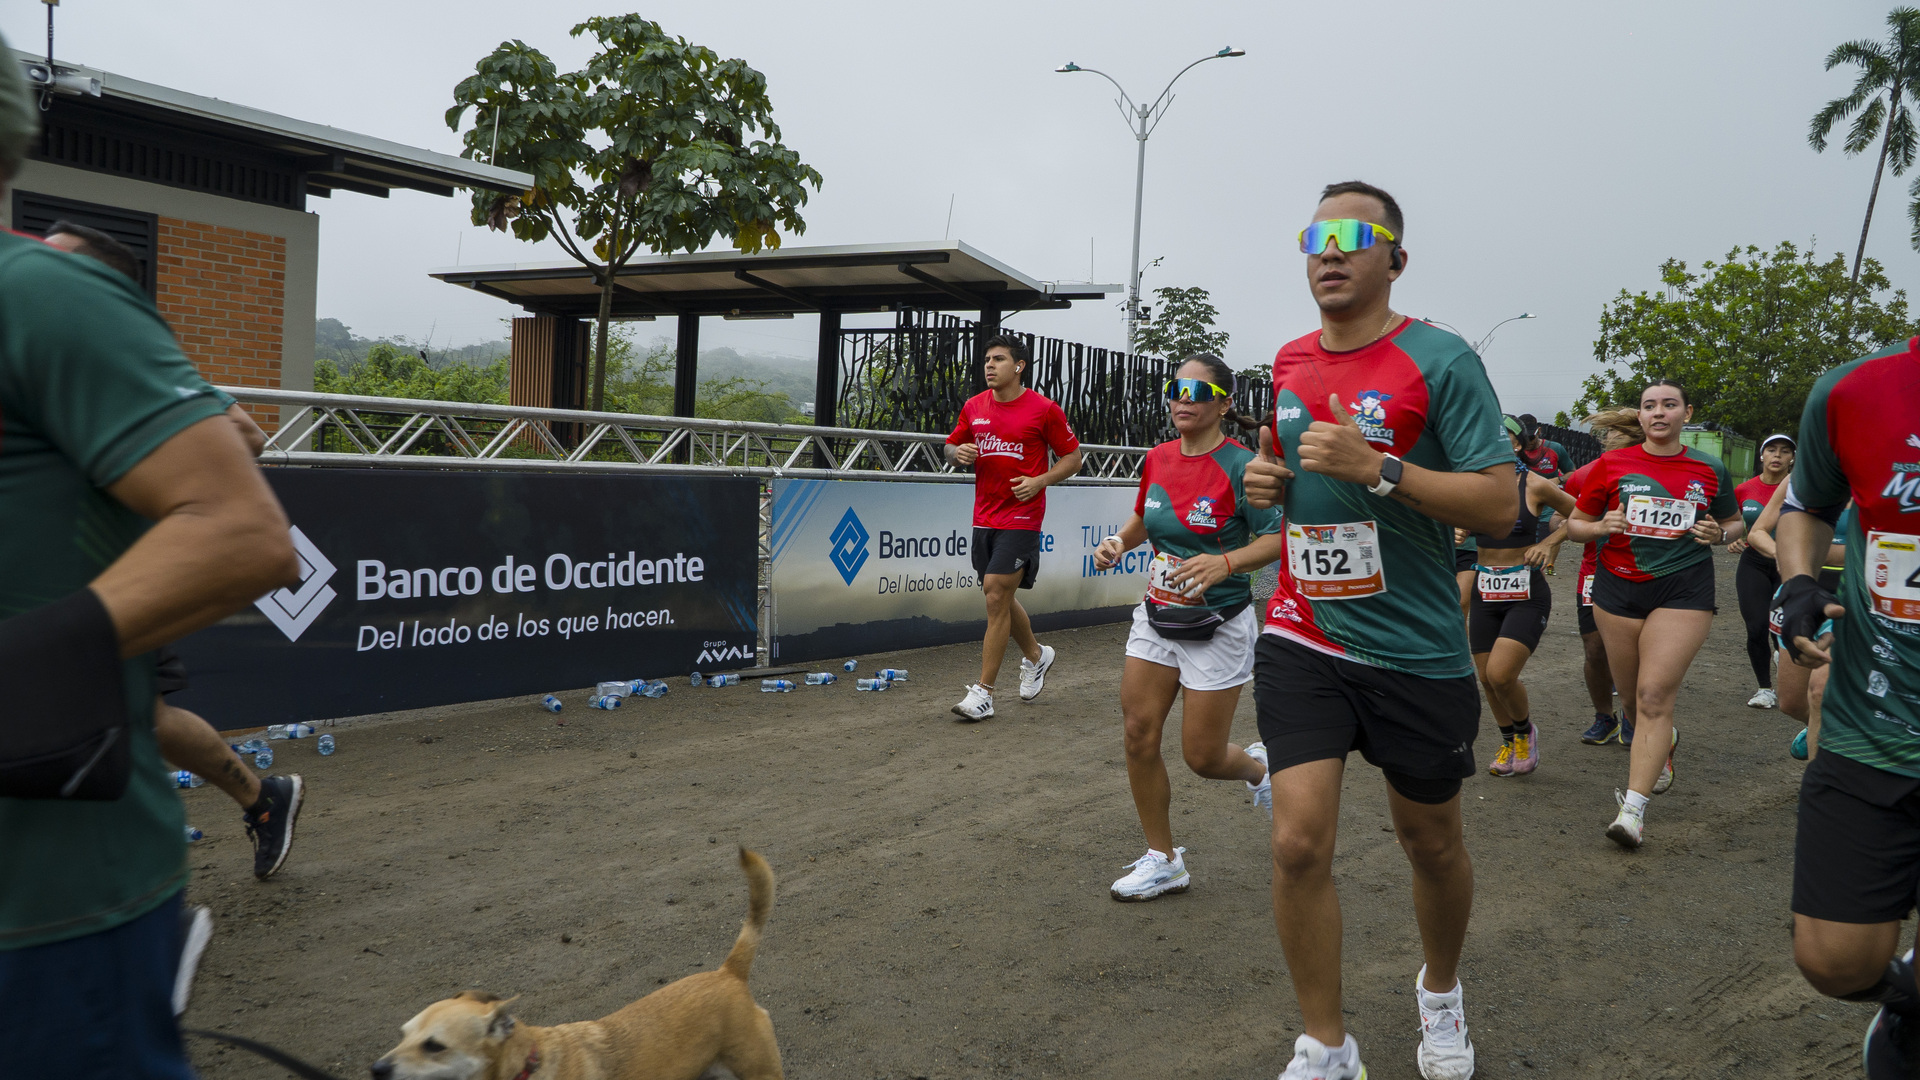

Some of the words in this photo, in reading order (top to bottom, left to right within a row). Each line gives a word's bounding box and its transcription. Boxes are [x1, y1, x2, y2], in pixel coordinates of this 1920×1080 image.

[975, 437, 1024, 454] Muñeca
[1638, 508, 1682, 528] 1120
[878, 531, 941, 559] Banco
[945, 530, 968, 556] de
[1082, 525, 1101, 548] TU
[1301, 548, 1352, 576] 152
[356, 559, 483, 601] Banco
[492, 555, 537, 594] de
[544, 551, 705, 591] Occidente
[878, 574, 902, 595] Del
[904, 573, 934, 593] lado
[936, 572, 953, 590] de
[956, 571, 974, 589] los
[1485, 577, 1520, 591] 1074
[356, 621, 405, 652] Del
[412, 618, 472, 647] lado
[477, 614, 510, 641] de
[516, 612, 550, 638] los
[556, 614, 600, 640] que
[606, 606, 676, 630] hacen.
[696, 644, 754, 664] AVAL
[703, 640, 727, 648] Grupo
